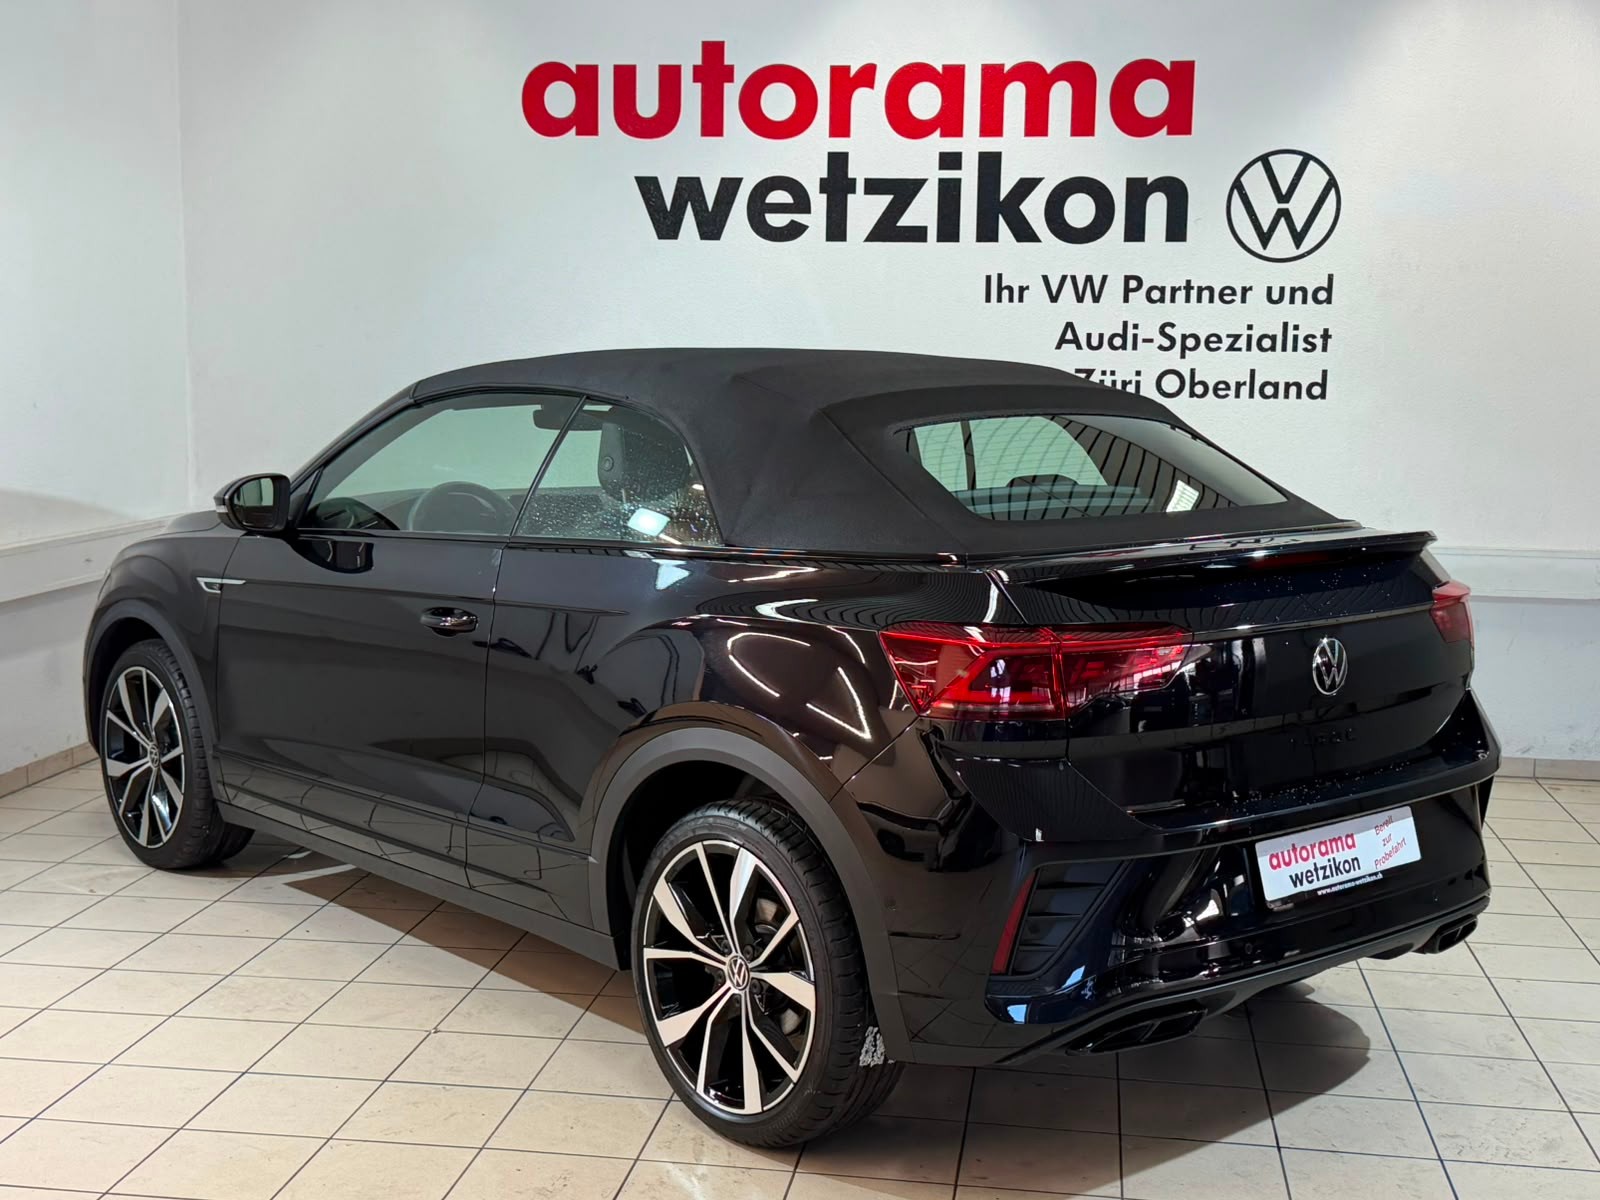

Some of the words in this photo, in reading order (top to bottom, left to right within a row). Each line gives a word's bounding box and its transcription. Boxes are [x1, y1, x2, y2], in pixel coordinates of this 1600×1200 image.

[522, 42, 1195, 140] autorama
[635, 152, 1188, 244] wetzikon
[984, 272, 1030, 304] Ihr
[1042, 274, 1109, 304] VW
[1122, 274, 1253, 305] Partner
[1266, 273, 1334, 305] und
[1055, 320, 1333, 360] Audi-Spezialist
[1155, 367, 1328, 400] Oberland
[1268, 832, 1357, 871] autorama
[1288, 856, 1361, 889] wetzikon
